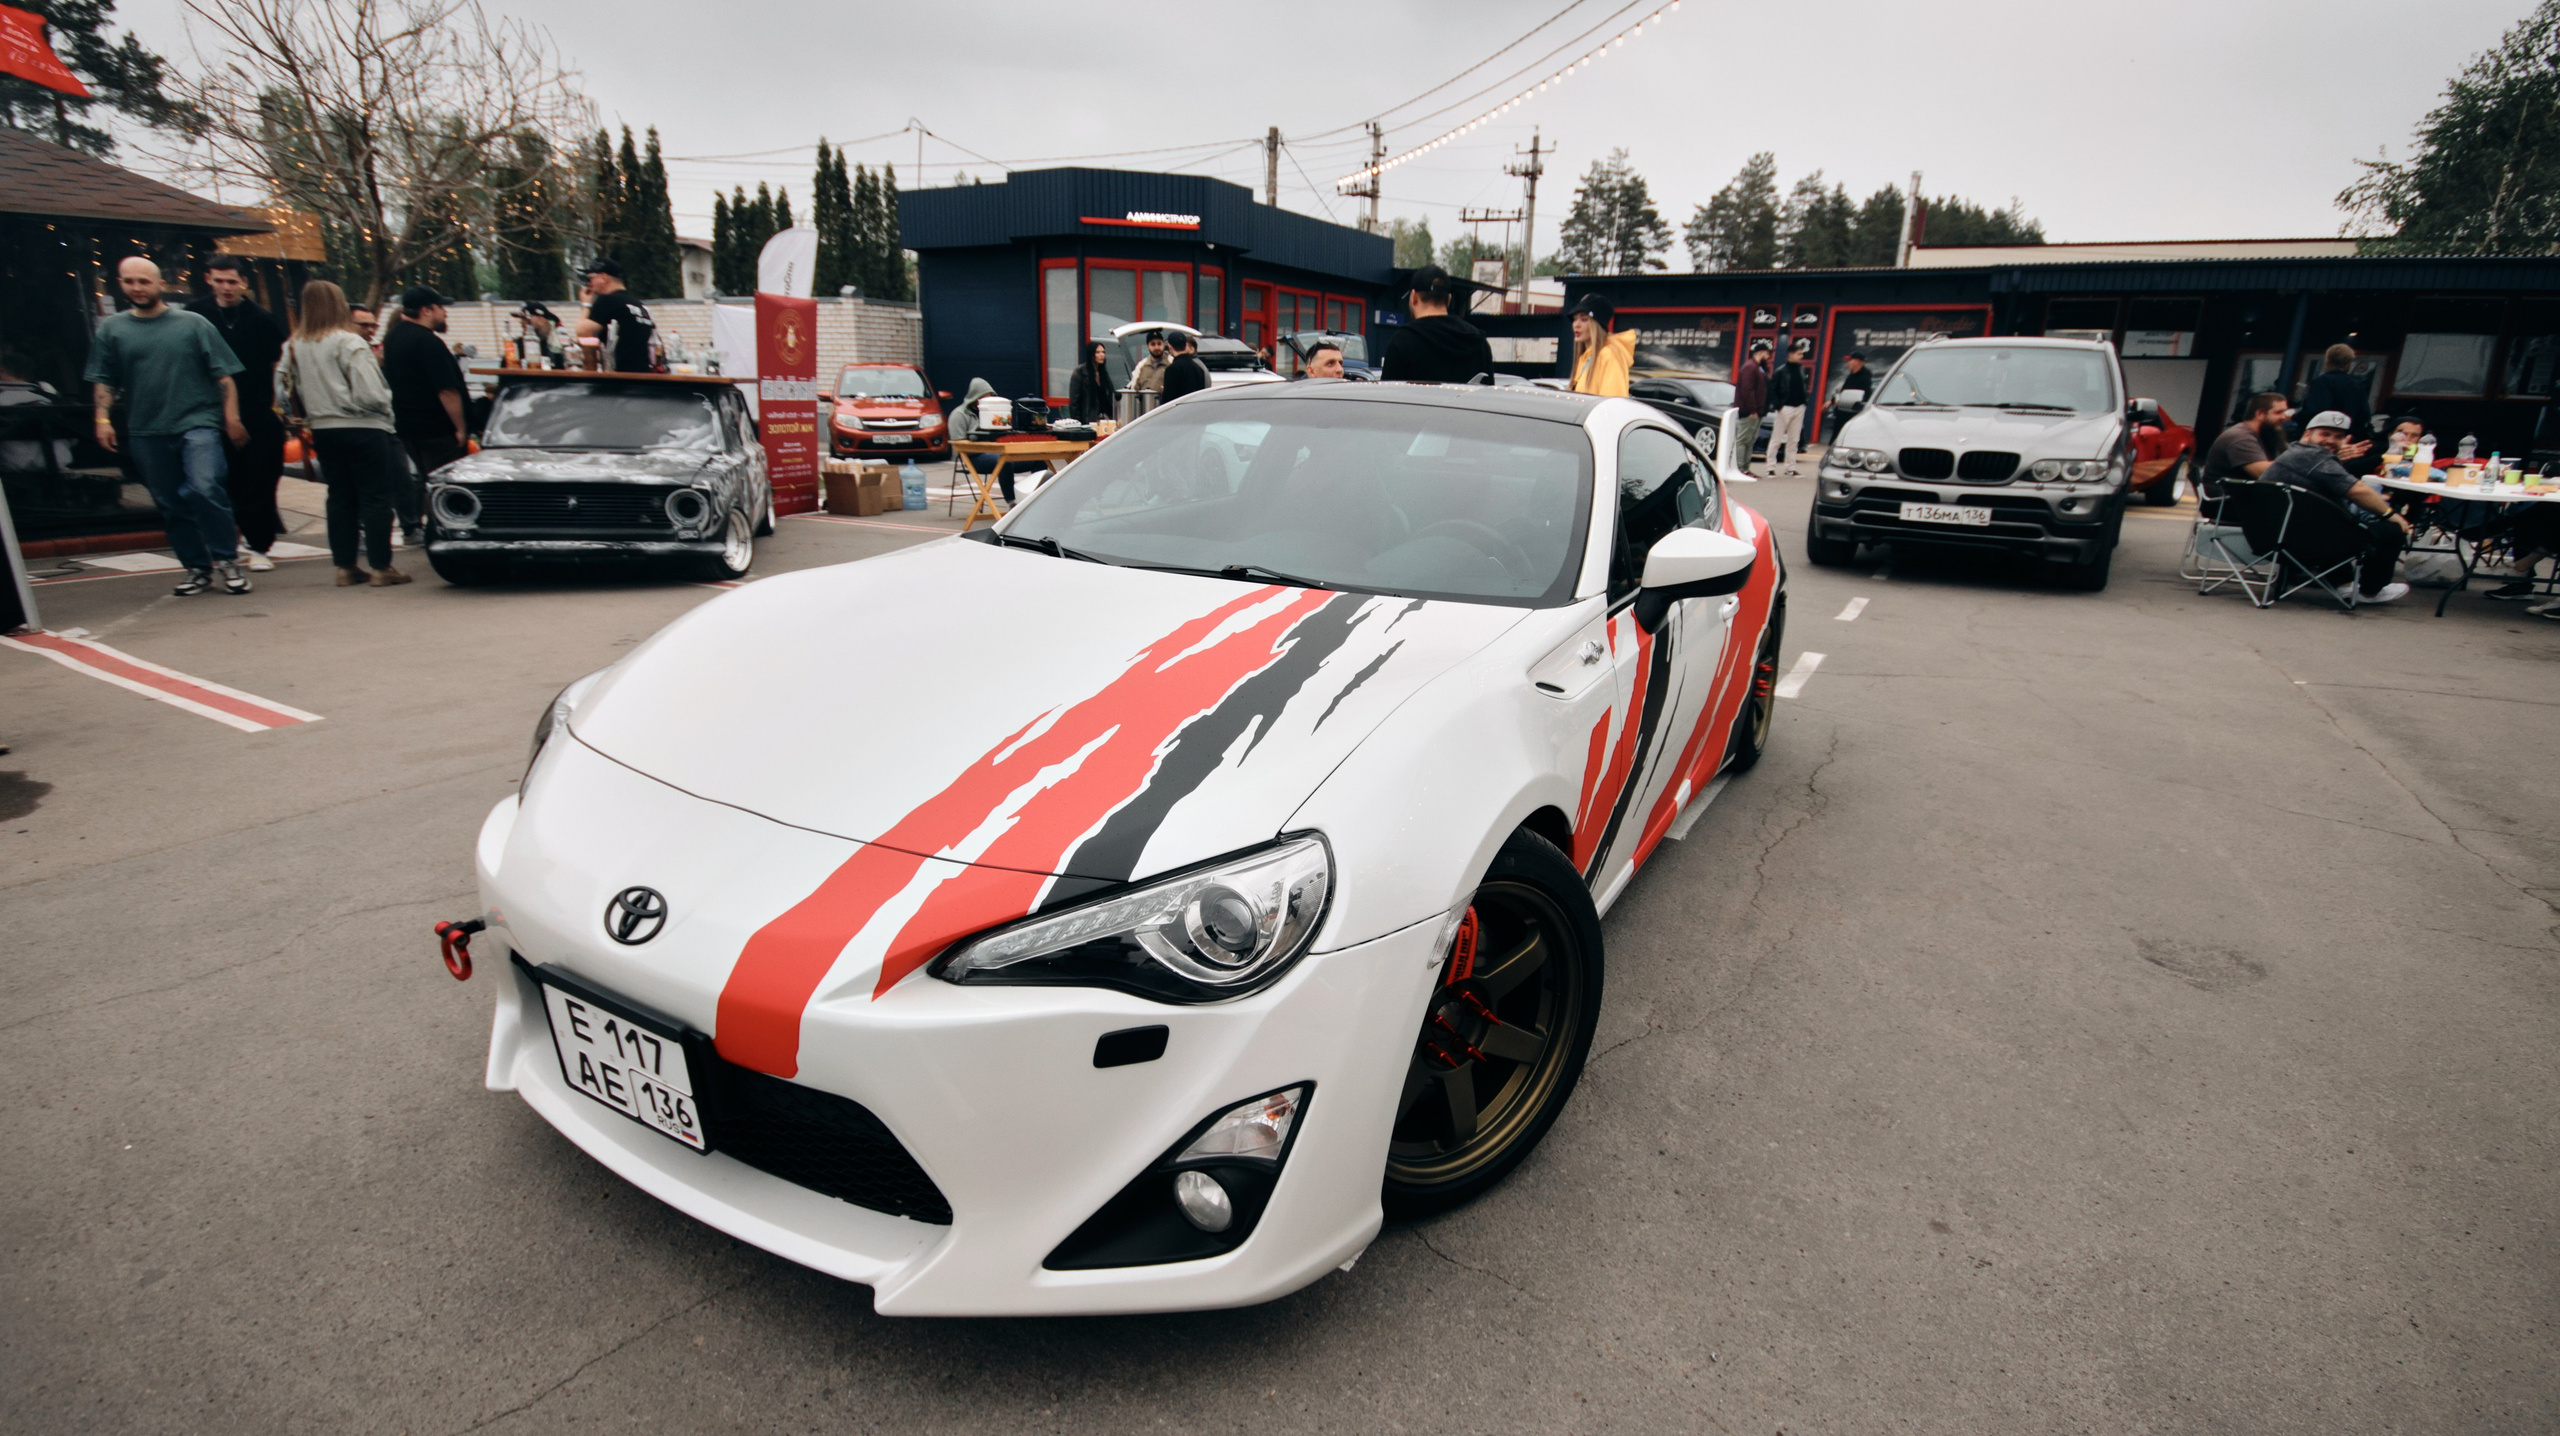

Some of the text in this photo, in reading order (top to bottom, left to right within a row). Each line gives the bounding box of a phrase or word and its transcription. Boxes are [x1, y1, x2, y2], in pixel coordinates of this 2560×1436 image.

[1126, 211, 1200, 225] АДМИНИСТРАТОР
[1853, 328, 1948, 346] Tunin
[1965, 509, 1986, 520] 136
[604, 1019, 661, 1075] 117
[641, 1082, 693, 1128] 136
[657, 1115, 681, 1134] RUS
